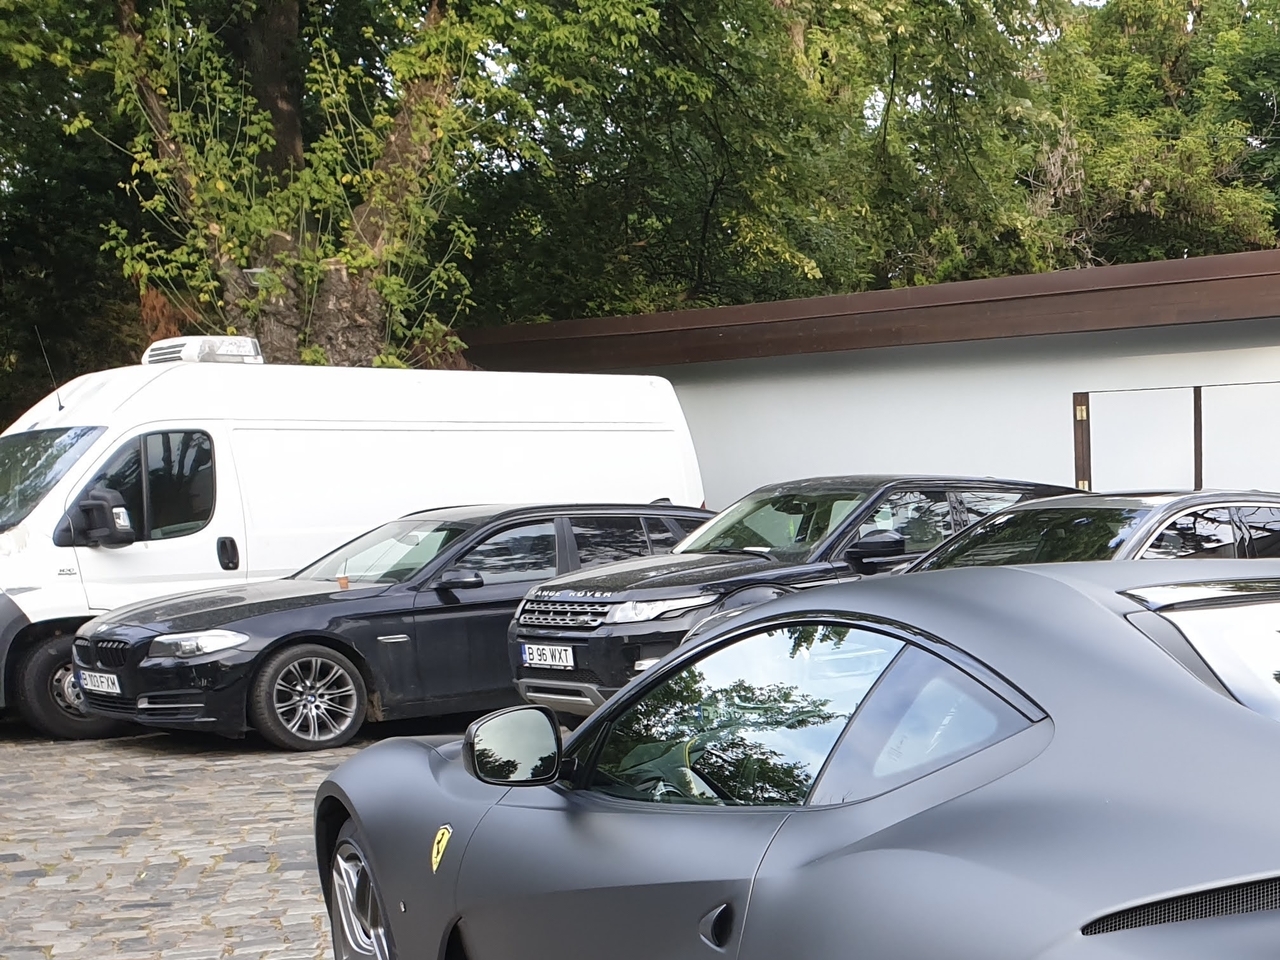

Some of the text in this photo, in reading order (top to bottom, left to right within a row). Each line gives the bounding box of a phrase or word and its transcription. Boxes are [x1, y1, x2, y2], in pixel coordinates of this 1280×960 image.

[527, 646, 569, 664] B 96 WXT
